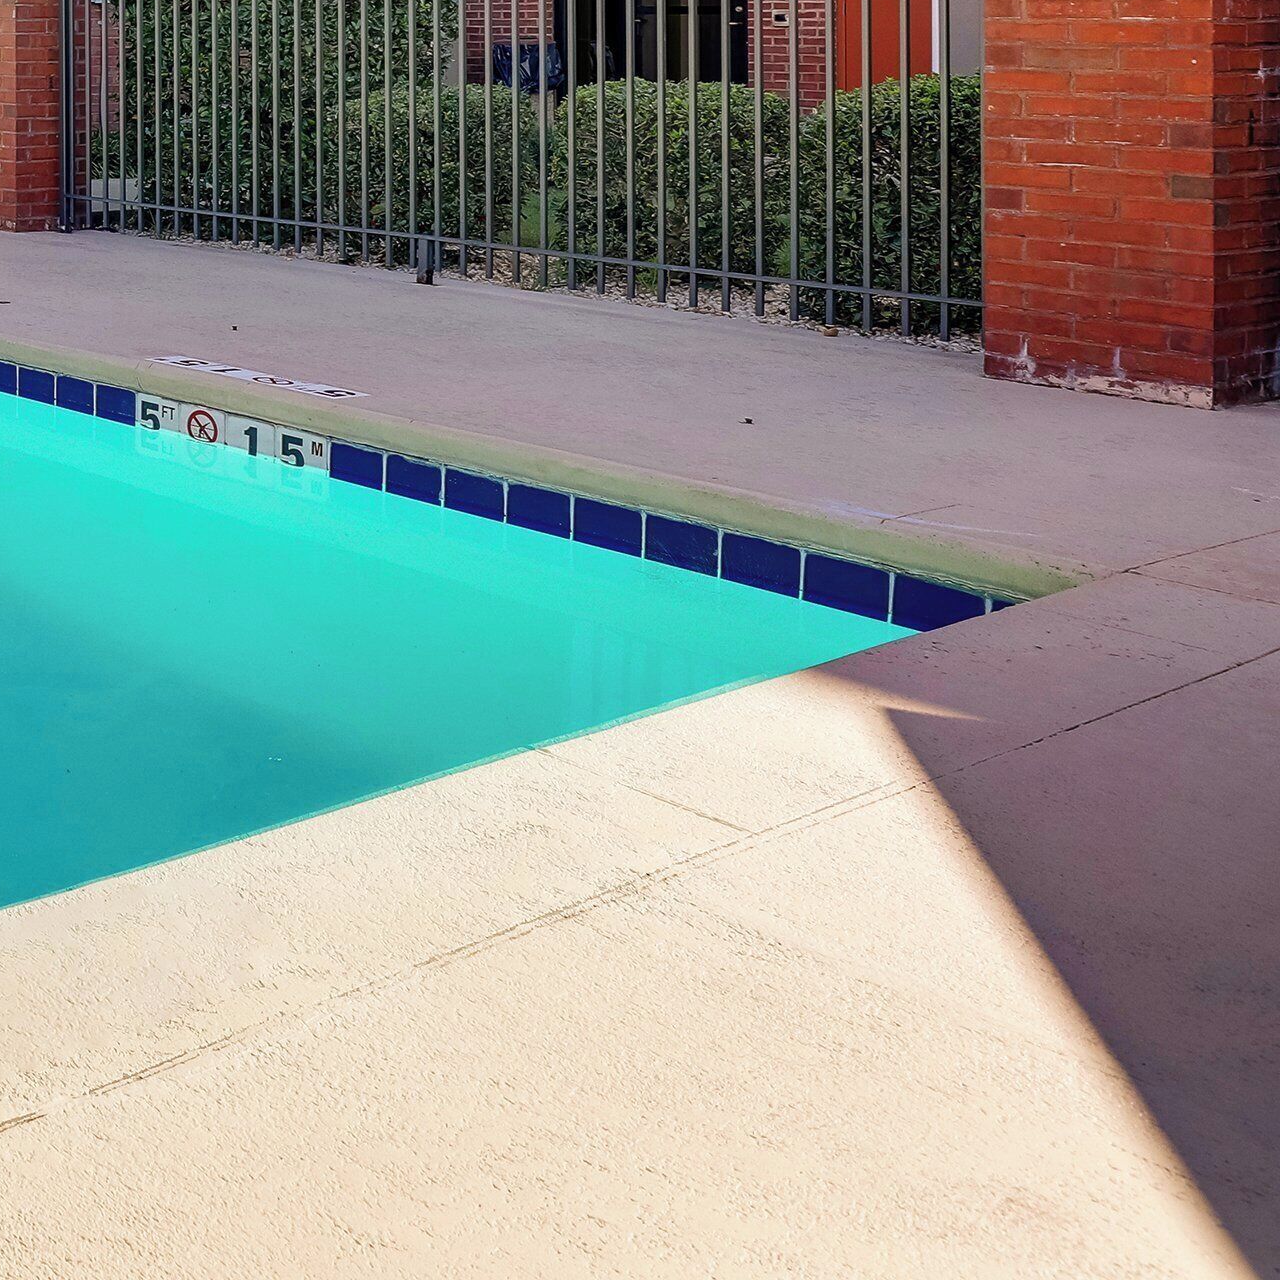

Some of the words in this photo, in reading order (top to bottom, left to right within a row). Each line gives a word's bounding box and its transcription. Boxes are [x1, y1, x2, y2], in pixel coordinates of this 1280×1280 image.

[140, 400, 160, 431] 5
[161, 405, 176, 421] FT
[311, 441, 324, 458] M
